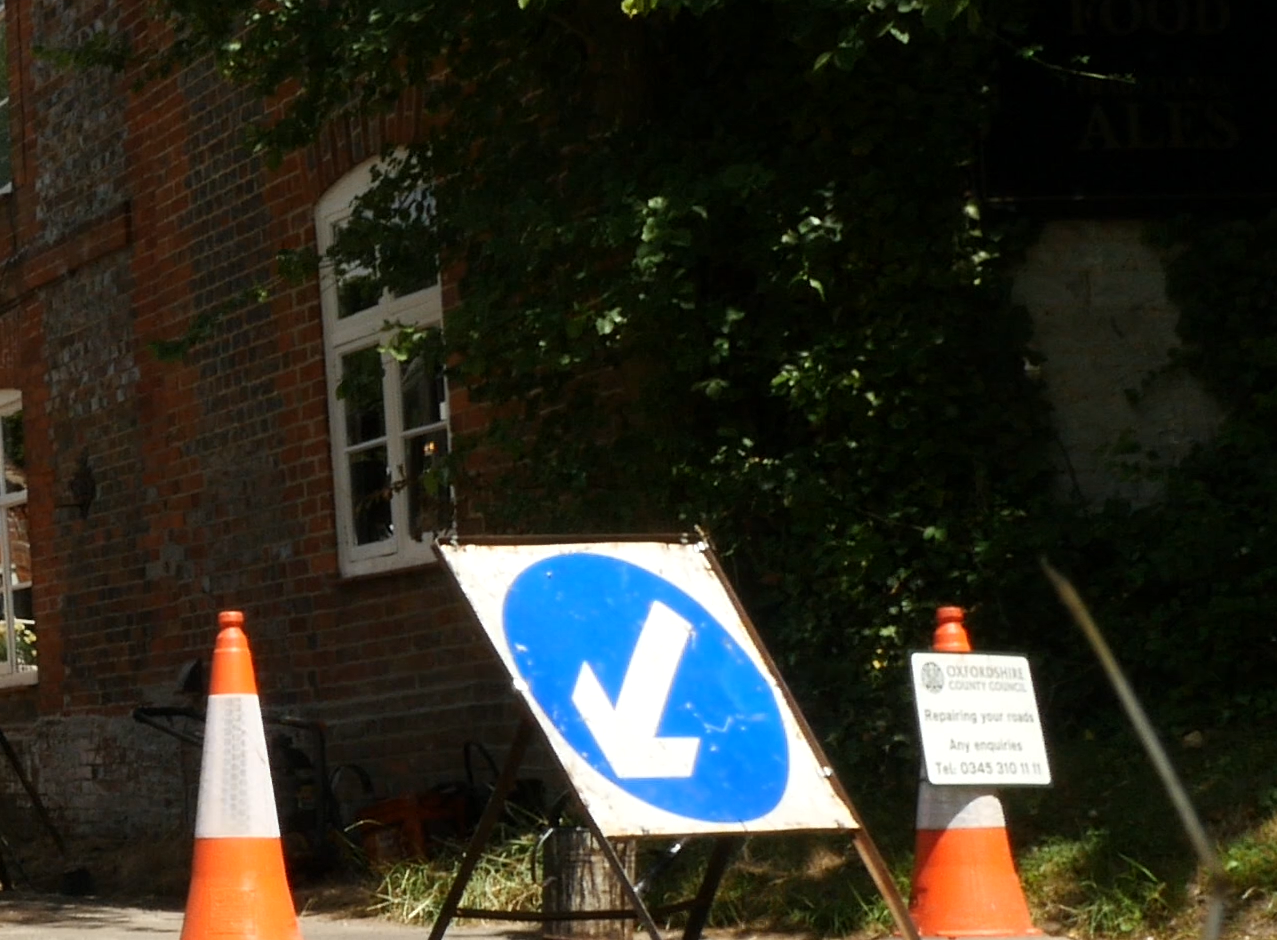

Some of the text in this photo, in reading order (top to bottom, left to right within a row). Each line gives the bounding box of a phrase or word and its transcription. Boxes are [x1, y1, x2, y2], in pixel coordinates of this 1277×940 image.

[946, 665, 1025, 680] OXFORDSHIRE
[948, 681, 1027, 692] COUNTY COUNCIL
[924, 709, 1035, 724] Repairing your roads
[949, 738, 1023, 753] Any enquiries
[960, 762, 993, 775] 0345
[996, 762, 1017, 775] 310
[1020, 763, 1030, 775] 11
[1032, 763, 1042, 775] 11
